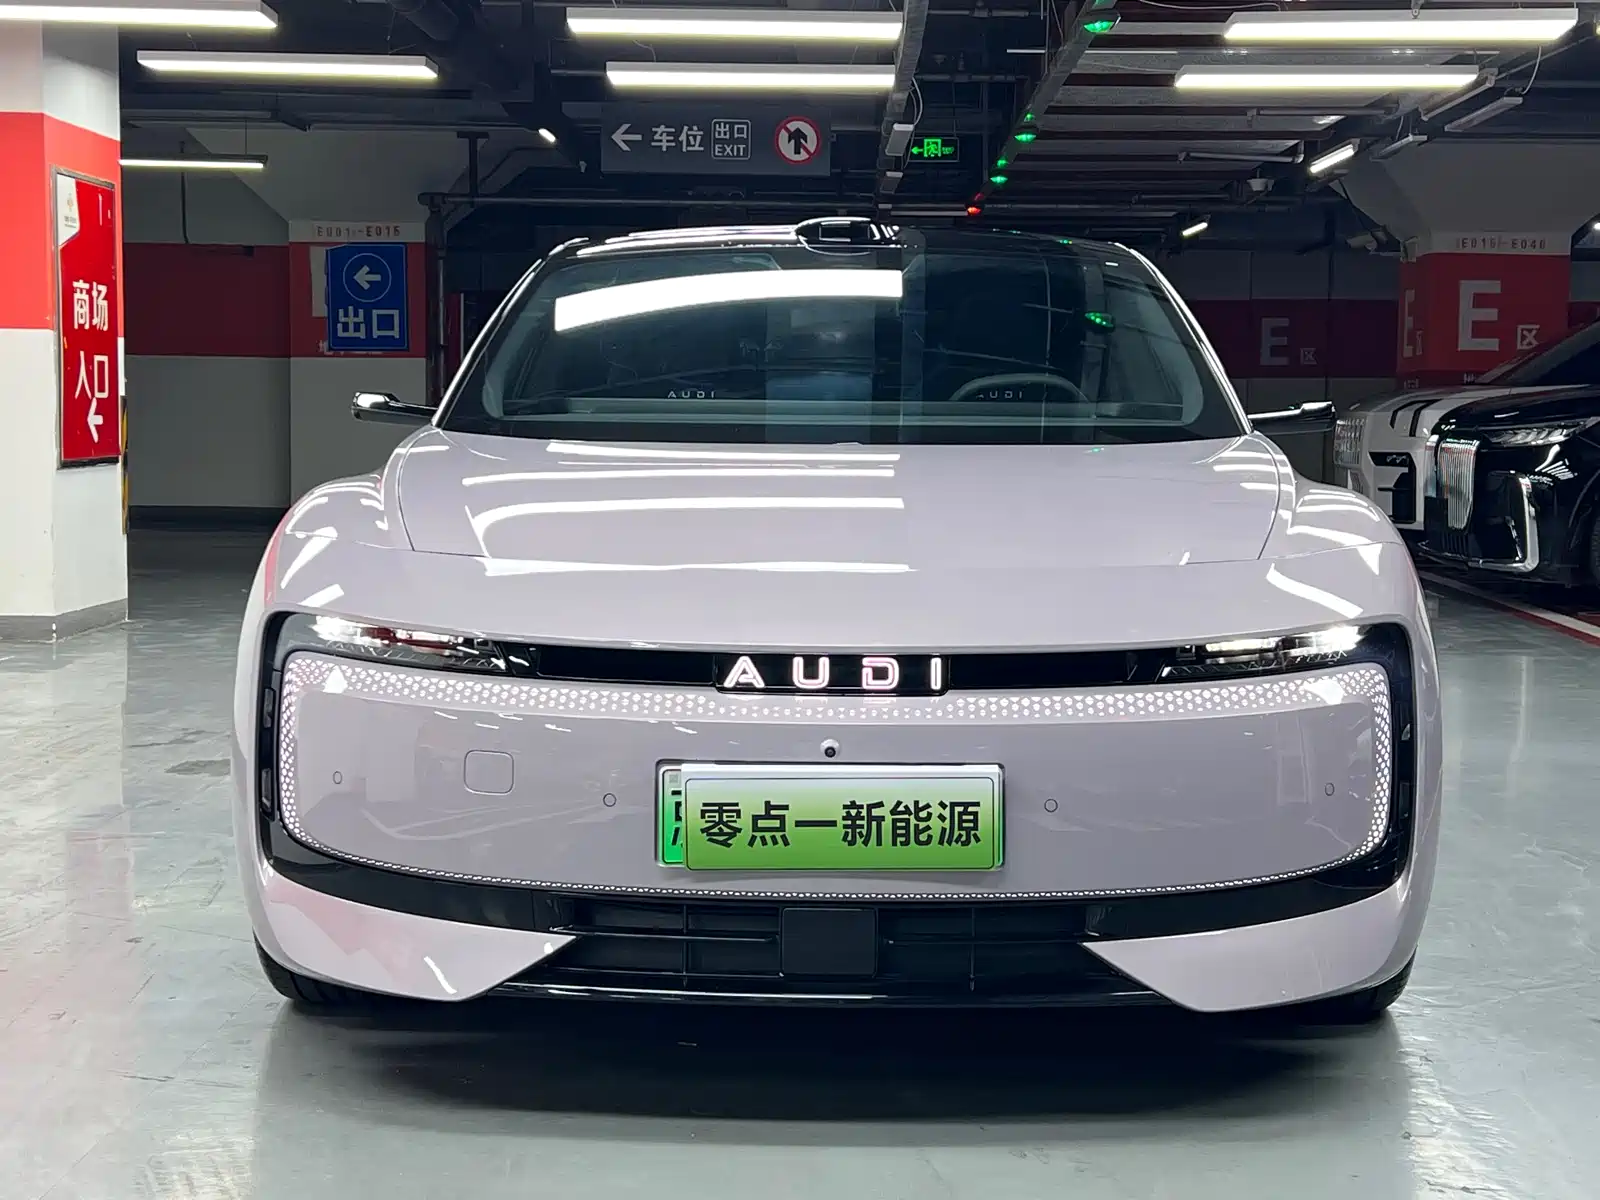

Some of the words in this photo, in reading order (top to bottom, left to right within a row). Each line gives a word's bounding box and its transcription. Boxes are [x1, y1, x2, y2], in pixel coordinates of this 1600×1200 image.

[650, 124, 705, 153] 车位
[714, 121, 748, 140] 出口
[714, 143, 747, 157] EXIT
[72, 279, 109, 331] 商场
[336, 306, 400, 339] 出口
[1456, 279, 1502, 352] E
[1259, 317, 1291, 366] E
[75, 350, 109, 400] 入口
[667, 390, 716, 399] AUDI
[722, 654, 943, 691] AUDI
[699, 799, 982, 849] 零点一新能源
